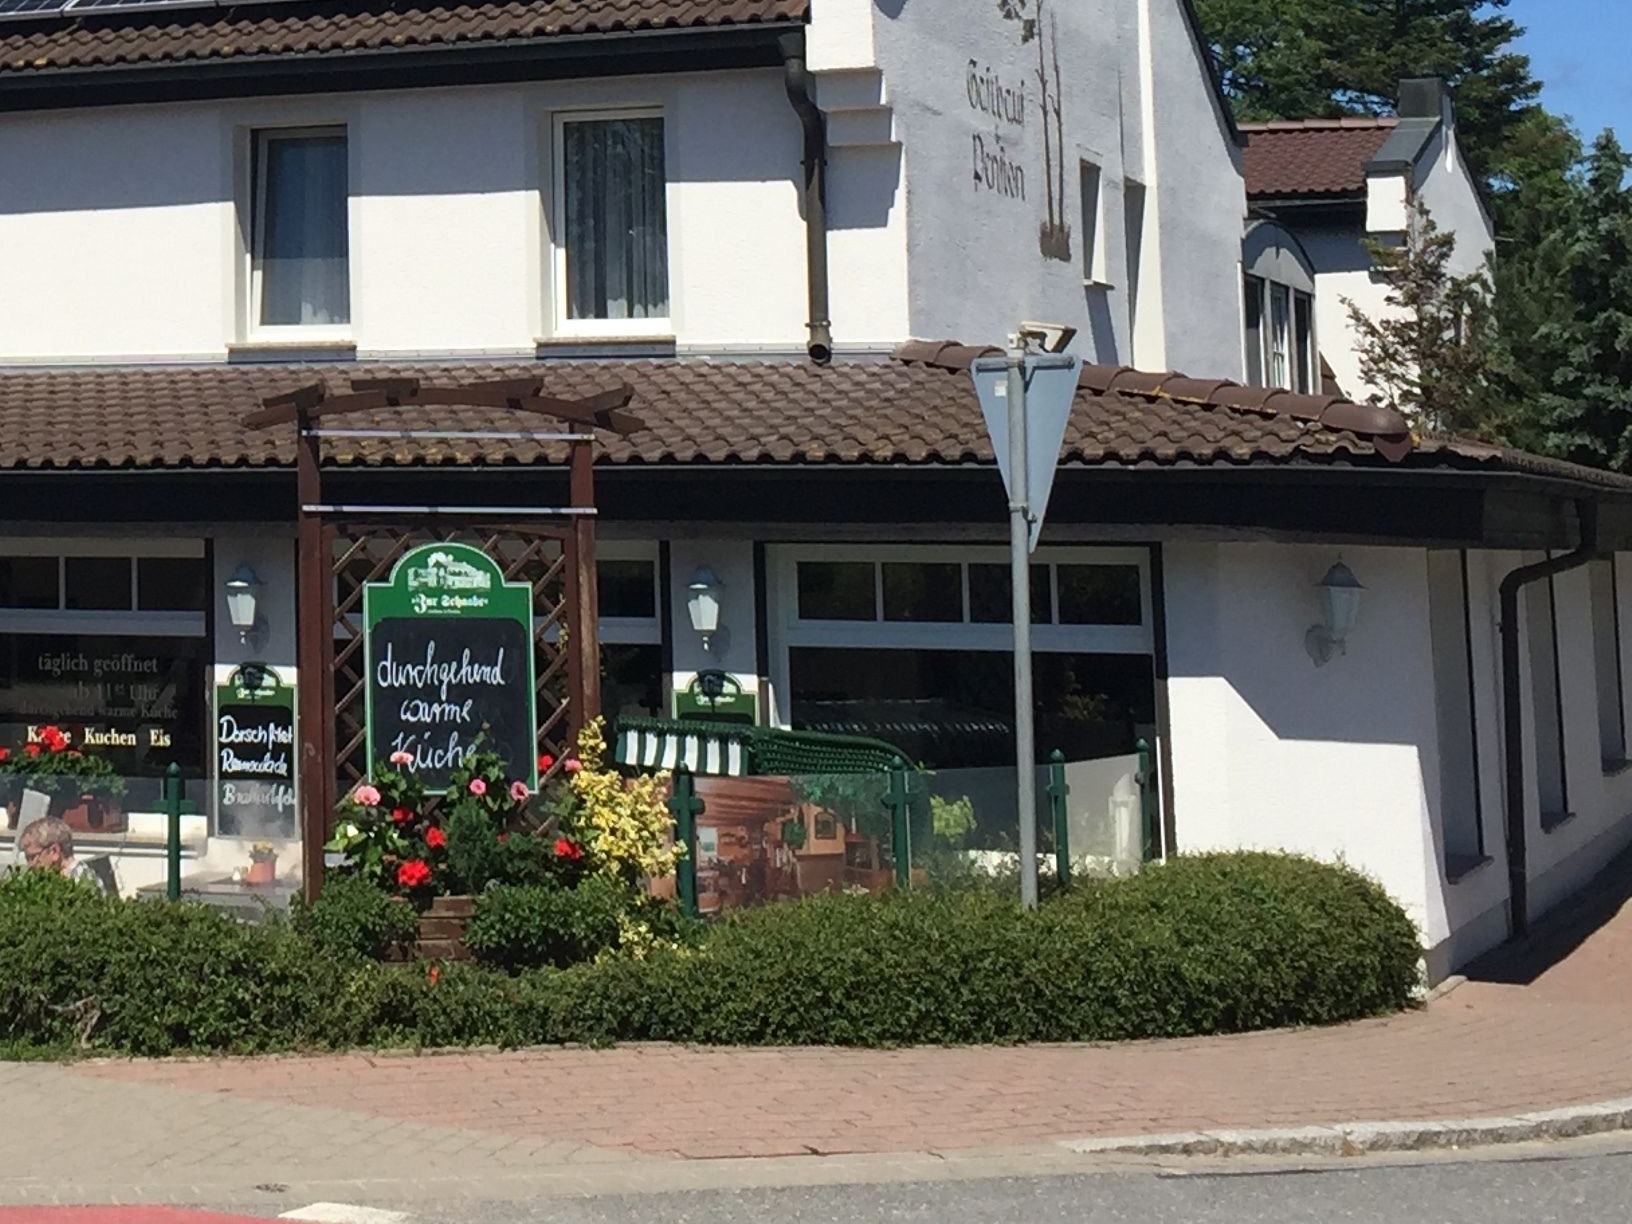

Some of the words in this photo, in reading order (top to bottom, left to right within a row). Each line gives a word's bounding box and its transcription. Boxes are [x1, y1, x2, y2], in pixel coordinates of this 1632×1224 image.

[38, 651, 89, 677] täglich
[93, 653, 158, 678] geöffnet
[377, 640, 506, 701] durchgehend
[400, 698, 473, 724] warme
[84, 728, 137, 747] Kuchen
[149, 729, 172, 748] Eis
[391, 730, 478, 774] Küche
